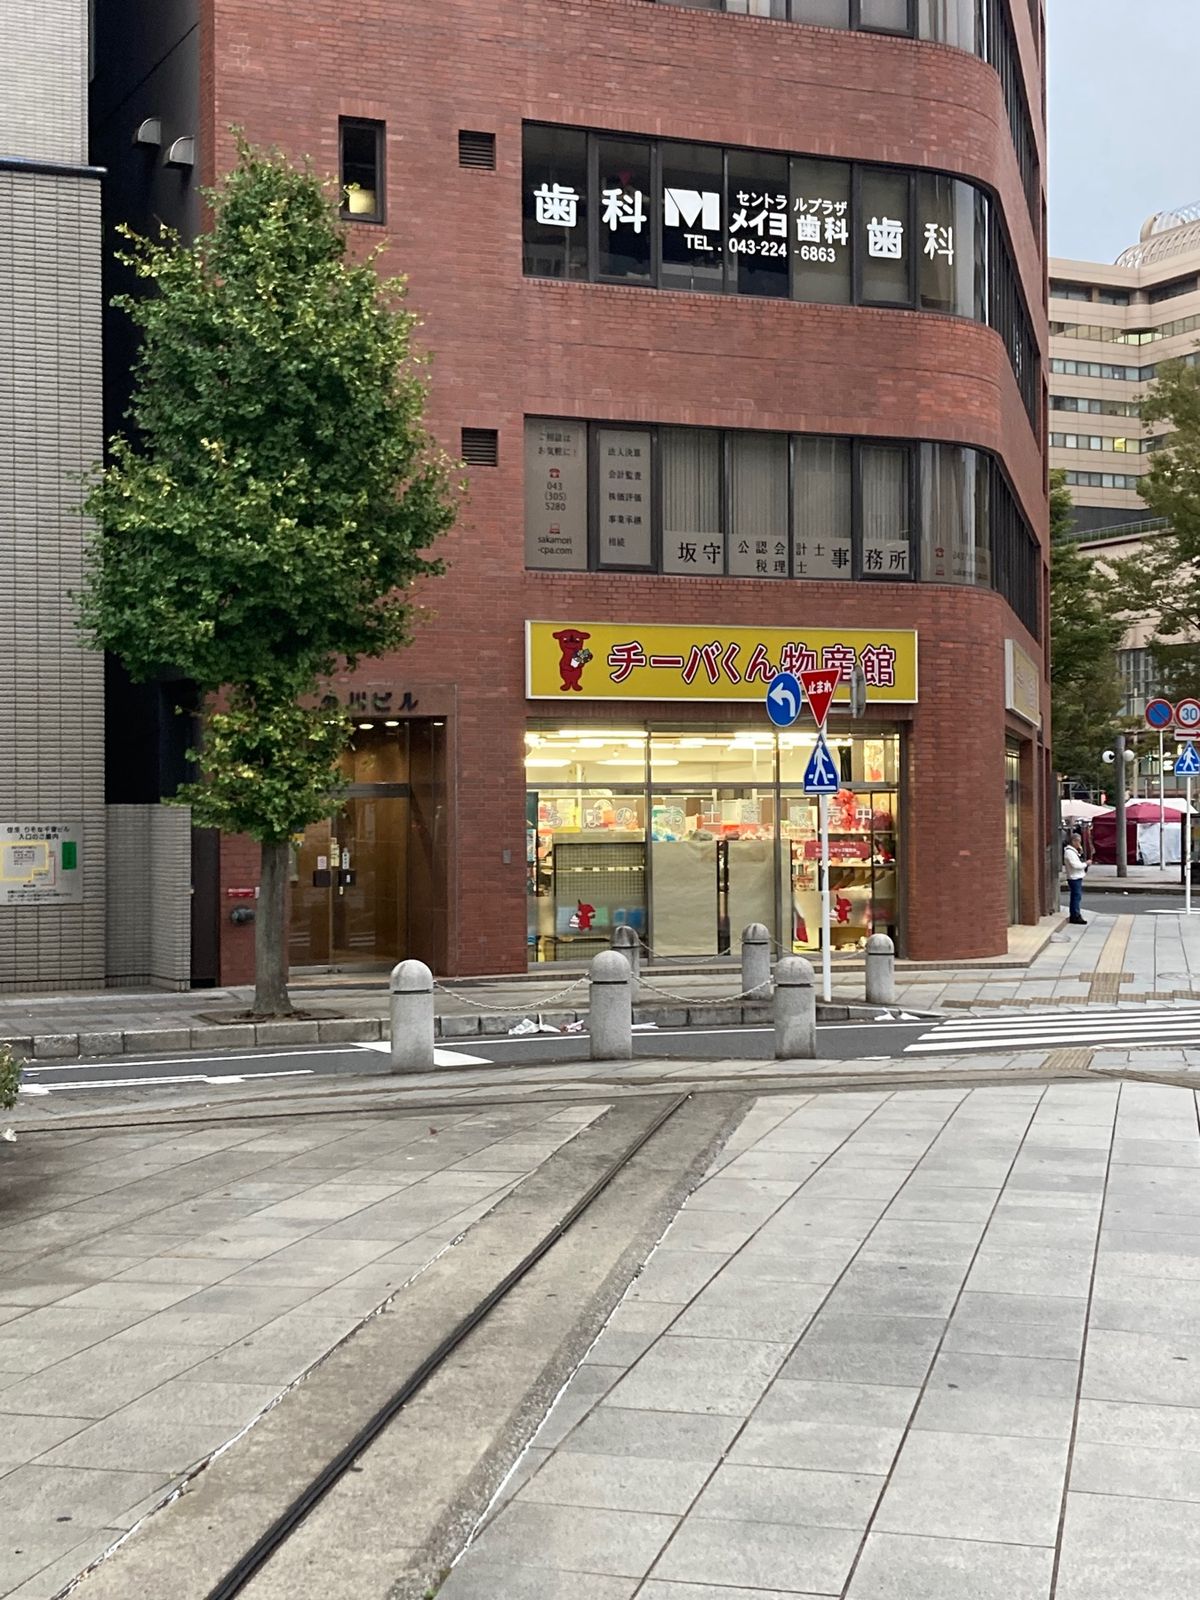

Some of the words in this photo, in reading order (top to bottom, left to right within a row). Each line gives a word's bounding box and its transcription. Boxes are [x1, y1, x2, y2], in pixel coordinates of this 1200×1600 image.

[533, 182, 648, 234] 歯科
[736, 189, 848, 216] セントラルプラザ
[728, 208, 848, 246] メイヨ歯科
[866, 216, 954, 266] 歯科
[729, 236, 836, 263] 043-224-6863
[608, 448, 641, 457] 法人決算
[608, 470, 642, 480] 会計監査
[546, 482, 563, 491] 043
[544, 491, 567, 502] (305)
[608, 492, 642, 502] 株価評価
[545, 502, 566, 512] 5280
[608, 514, 641, 525] 事業承継
[538, 535, 572, 545] sakamori
[608, 537, 625, 547] 相続
[538, 546, 573, 556] -cpa.com
[678, 541, 721, 565] 坂守
[738, 539, 826, 557] 公認会計士
[755, 558, 808, 575] 税理士
[830, 547, 908, 571] 事務所
[607, 640, 896, 687] チーバくん物産館
[808, 679, 833, 695] 止まれ
[1181, 707, 1198, 721] 30
